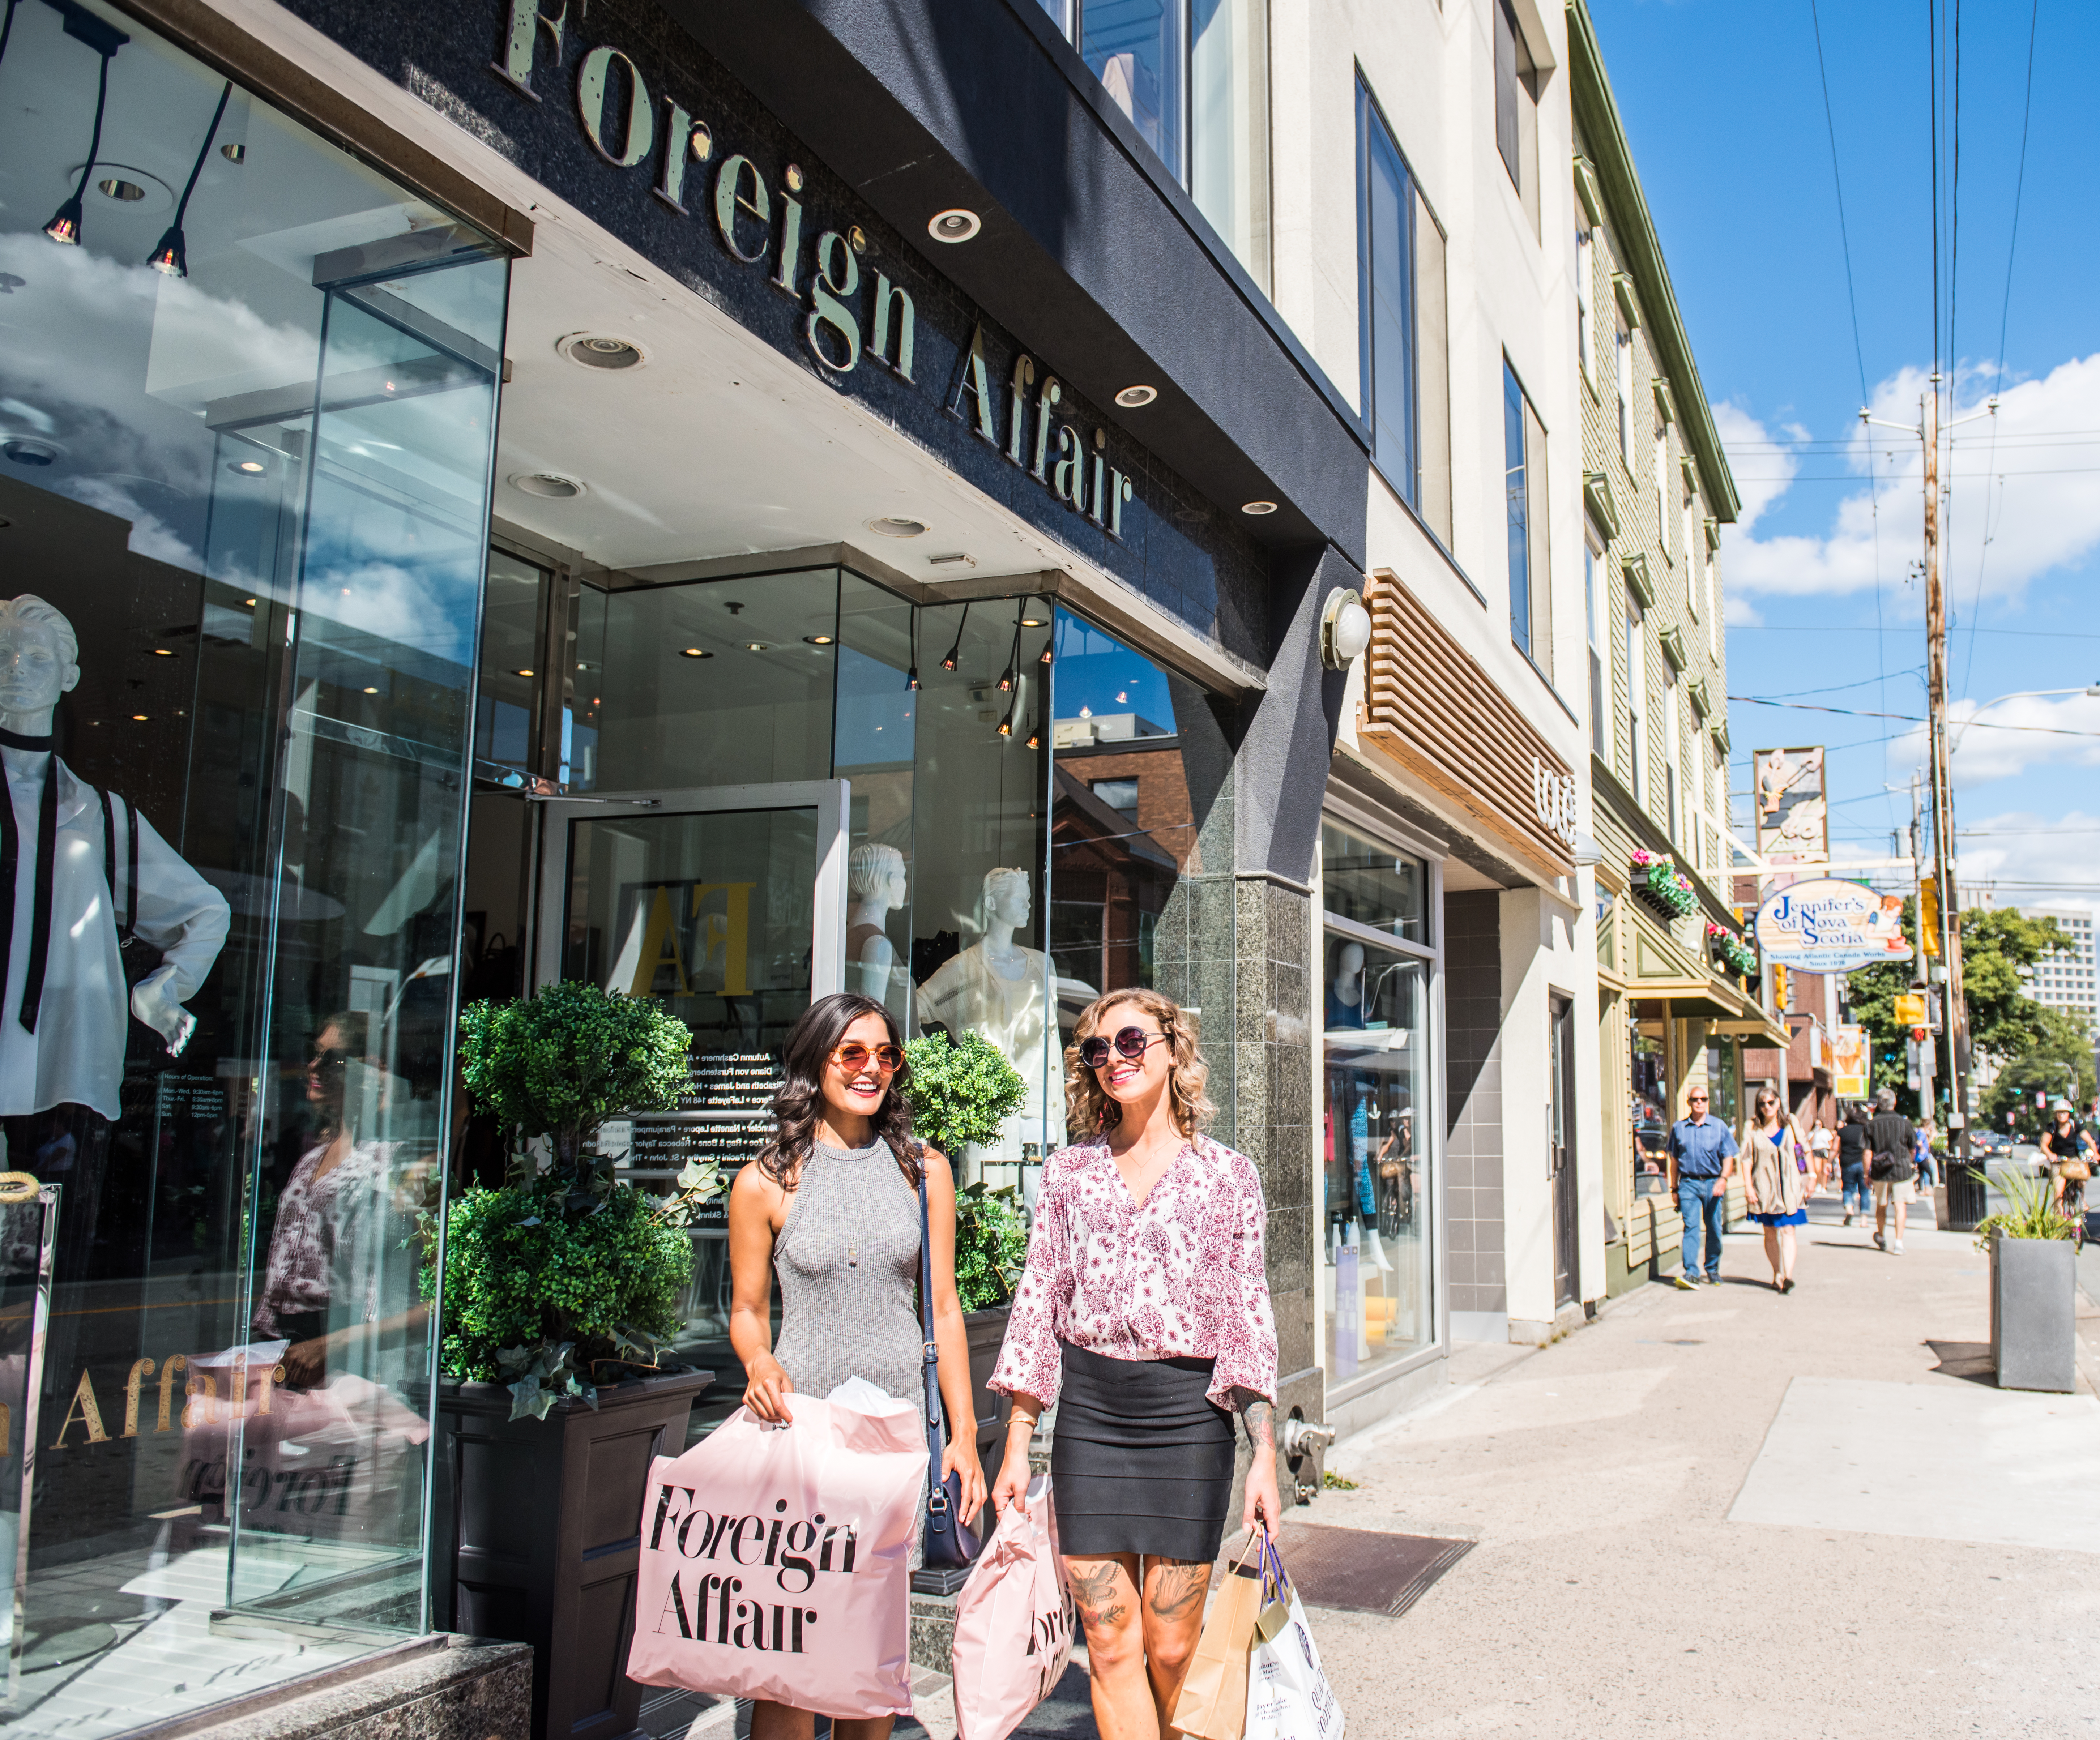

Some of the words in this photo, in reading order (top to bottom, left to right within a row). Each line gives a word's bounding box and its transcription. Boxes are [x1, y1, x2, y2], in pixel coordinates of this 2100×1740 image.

[489, 0, 916, 385] Foreign
[947, 320, 1123, 541] Affair
[1774, 896, 1864, 920] Jennifer's
[1782, 916, 1797, 929] of
[1801, 910, 1847, 929] Nova
[1804, 928, 1863, 944] Scotia
[49, 1353, 286, 1450] Affair
[646, 1483, 860, 1593] Foreign
[652, 1569, 818, 1654] Affair
[1257, 1700, 1275, 1711] Bayer
